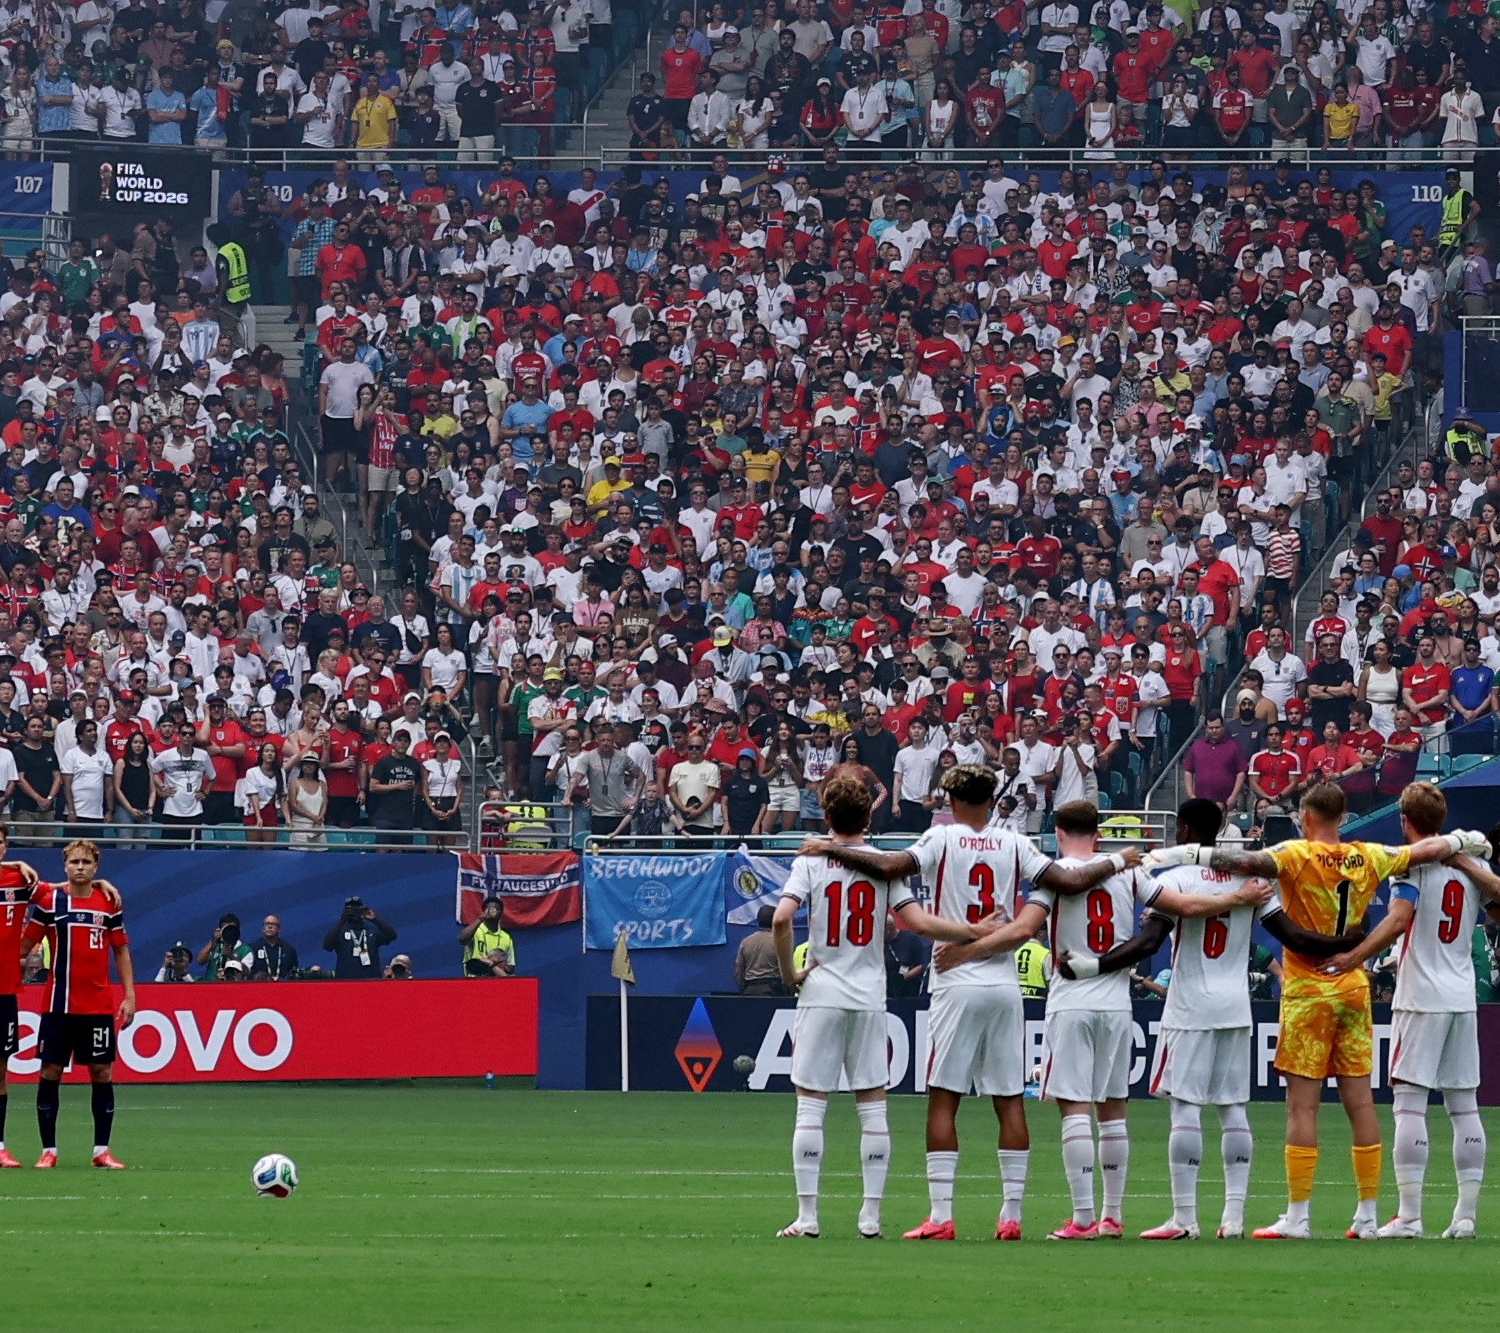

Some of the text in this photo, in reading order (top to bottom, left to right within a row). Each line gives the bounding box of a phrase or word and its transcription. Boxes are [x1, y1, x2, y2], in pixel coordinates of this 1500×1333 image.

[116, 163, 145, 176] FIFA
[14, 176, 43, 194] 107
[116, 176, 163, 190] WORLD
[1411, 185, 1443, 203] 110
[116, 190, 189, 204] CUP 2026
[590, 855, 715, 882] BEECHWOOD
[471, 875, 487, 889] FK
[966, 863, 995, 924] 3
[824, 880, 876, 947] 18
[1334, 880, 1351, 936] 1
[1438, 880, 1465, 943] 9
[613, 918, 694, 944] SPORTS
[1086, 889, 1115, 954] 8
[89, 928, 104, 949] 21
[1203, 910, 1230, 960] 6
[93, 1026, 110, 1048] 21
